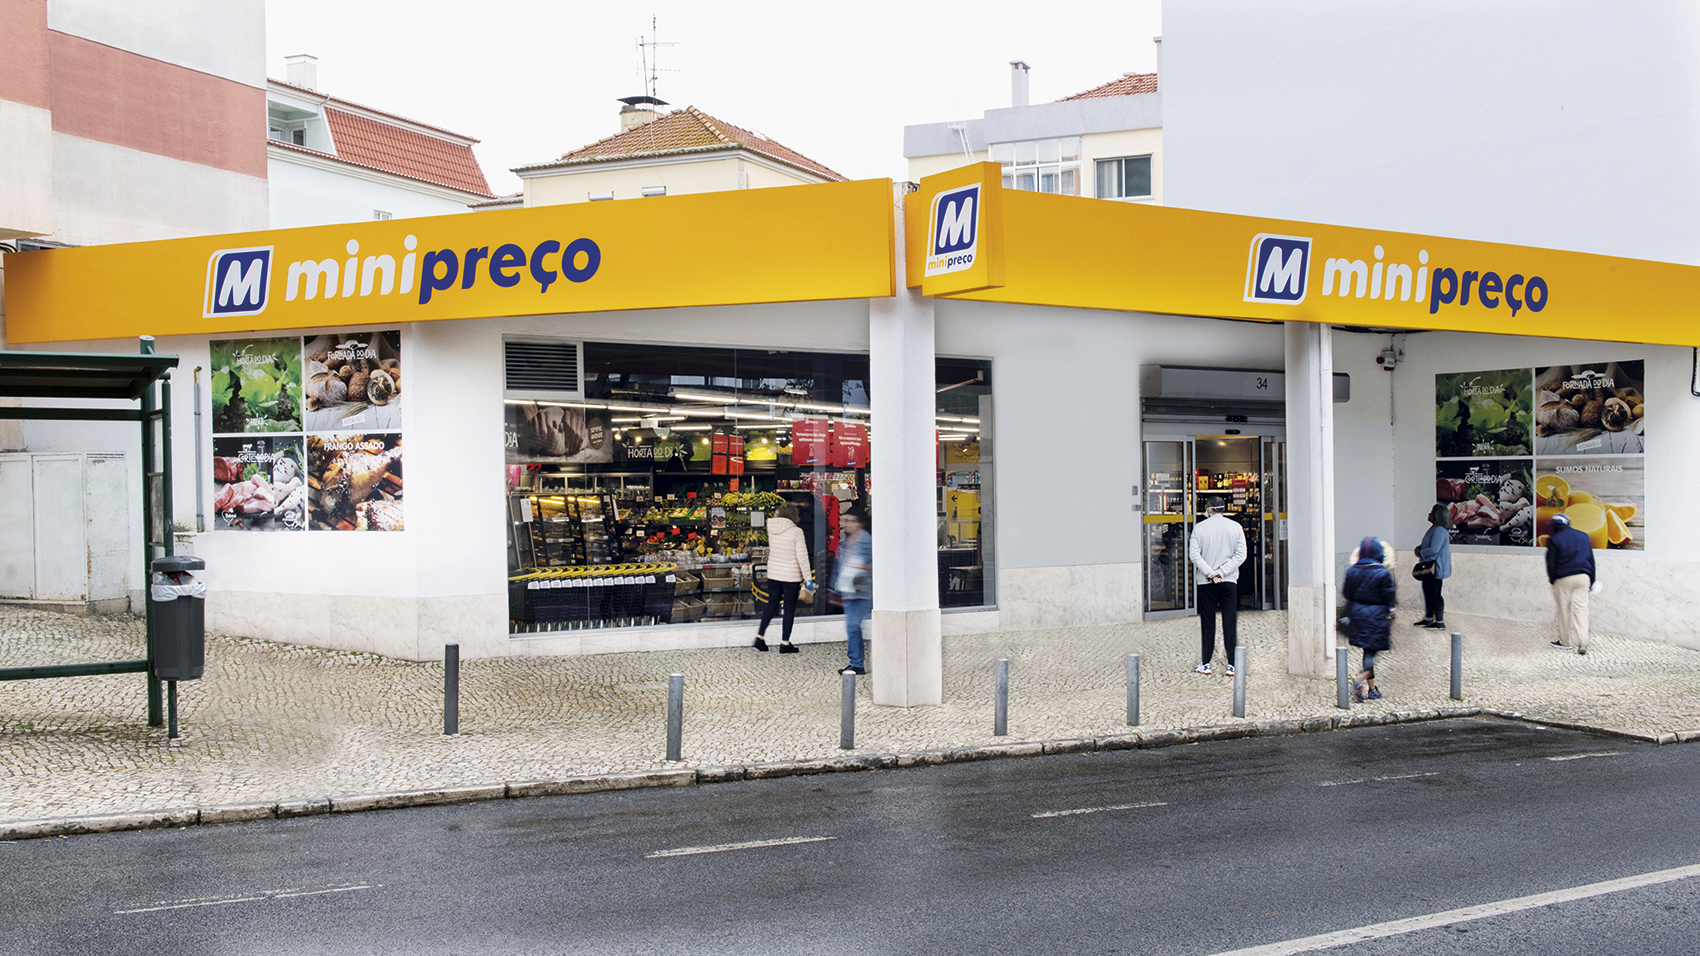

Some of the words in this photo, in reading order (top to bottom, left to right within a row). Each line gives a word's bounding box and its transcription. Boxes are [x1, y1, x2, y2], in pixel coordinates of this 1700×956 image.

[938, 196, 974, 249] M
[218, 258, 263, 307] M
[285, 234, 602, 305] minipreço
[1259, 246, 1303, 295] M
[1321, 244, 1549, 318] minipreço
[1256, 377, 1268, 390] 34
[323, 442, 354, 450] FRANGO
[355, 441, 385, 450] ASSADO
[627, 448, 653, 458] HORTA
[653, 447, 663, 456] DO
[1555, 466, 1583, 474] SUMOS
[1585, 465, 1624, 473] NATURAIS
